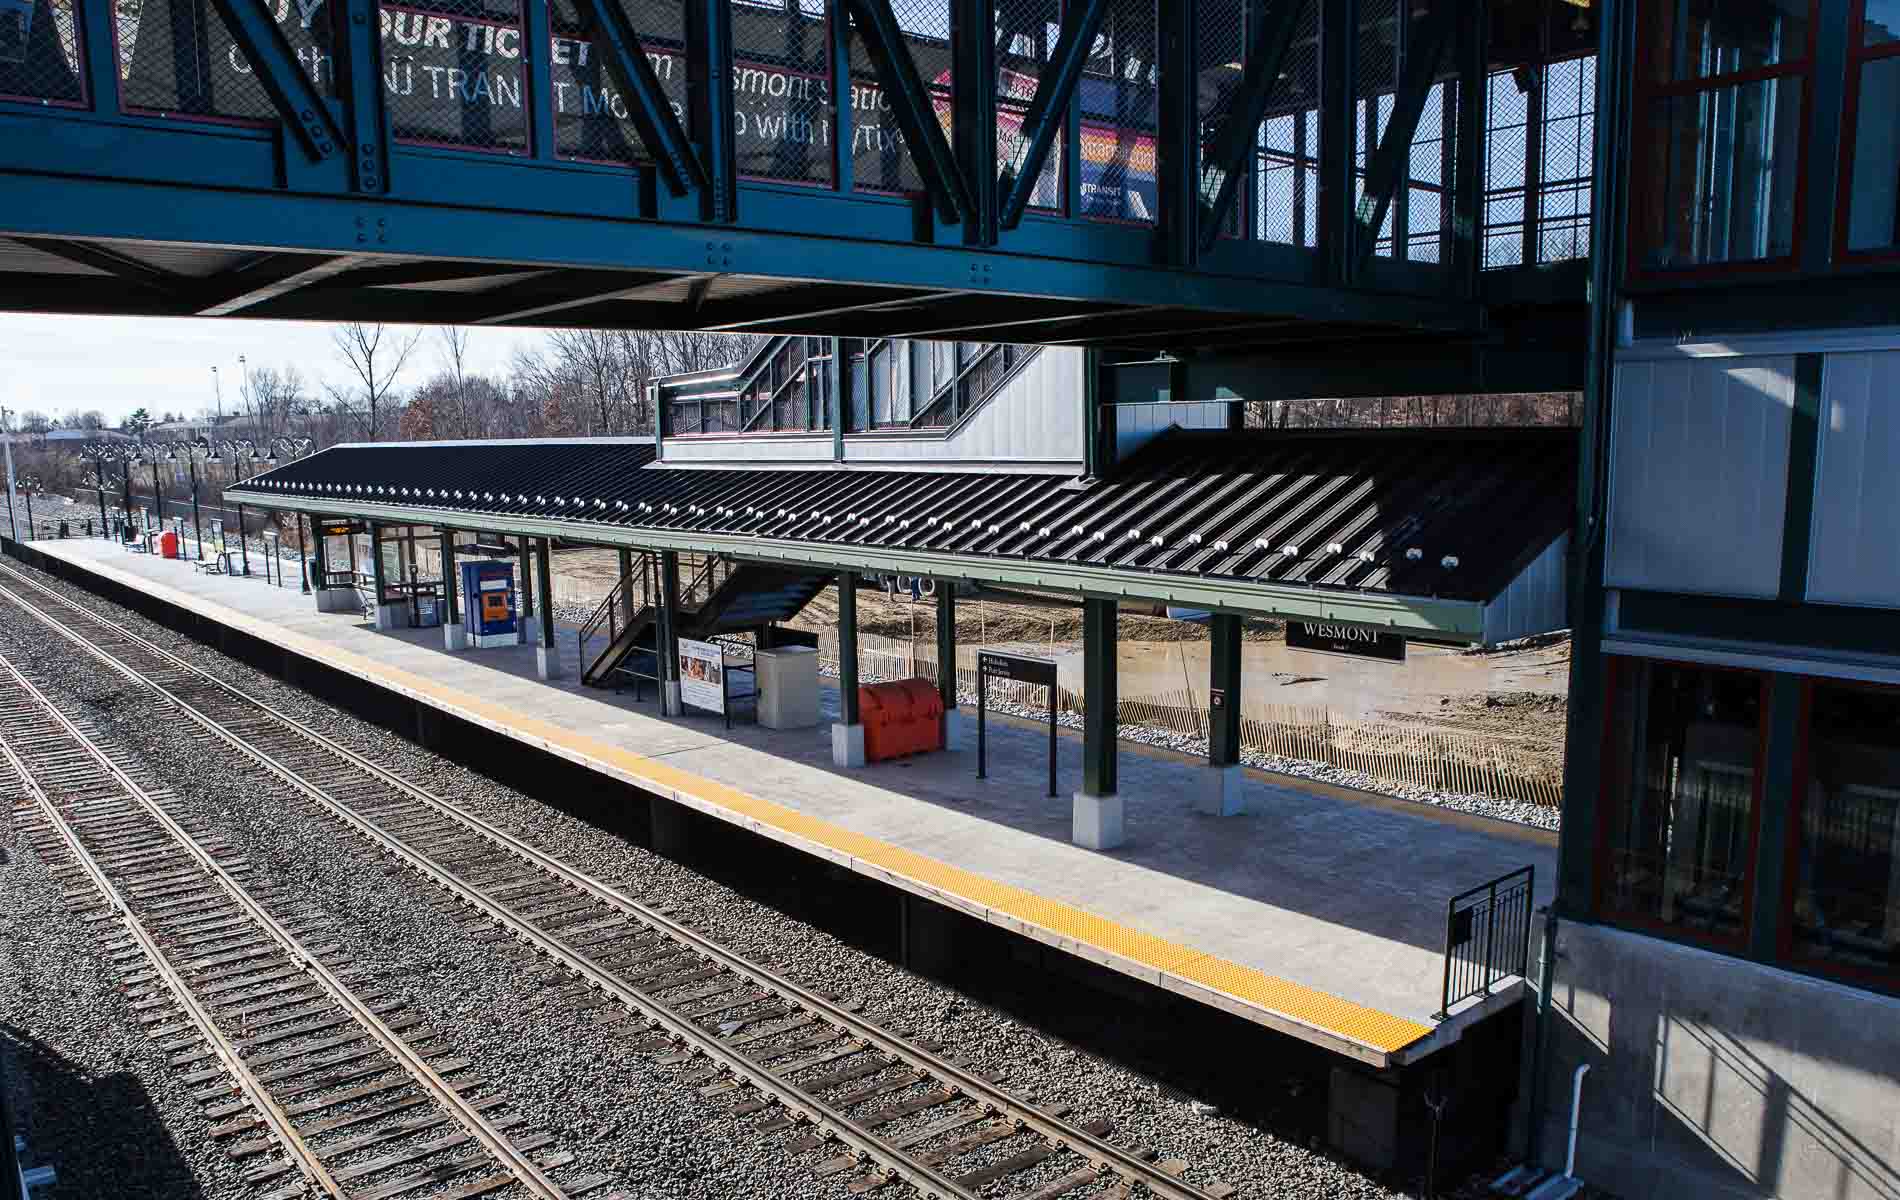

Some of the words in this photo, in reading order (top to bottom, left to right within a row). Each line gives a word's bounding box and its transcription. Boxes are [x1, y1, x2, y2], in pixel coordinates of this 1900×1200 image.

[461, 22, 592, 66] TICET
[422, 64, 569, 113] TRANT
[756, 111, 815, 145] with
